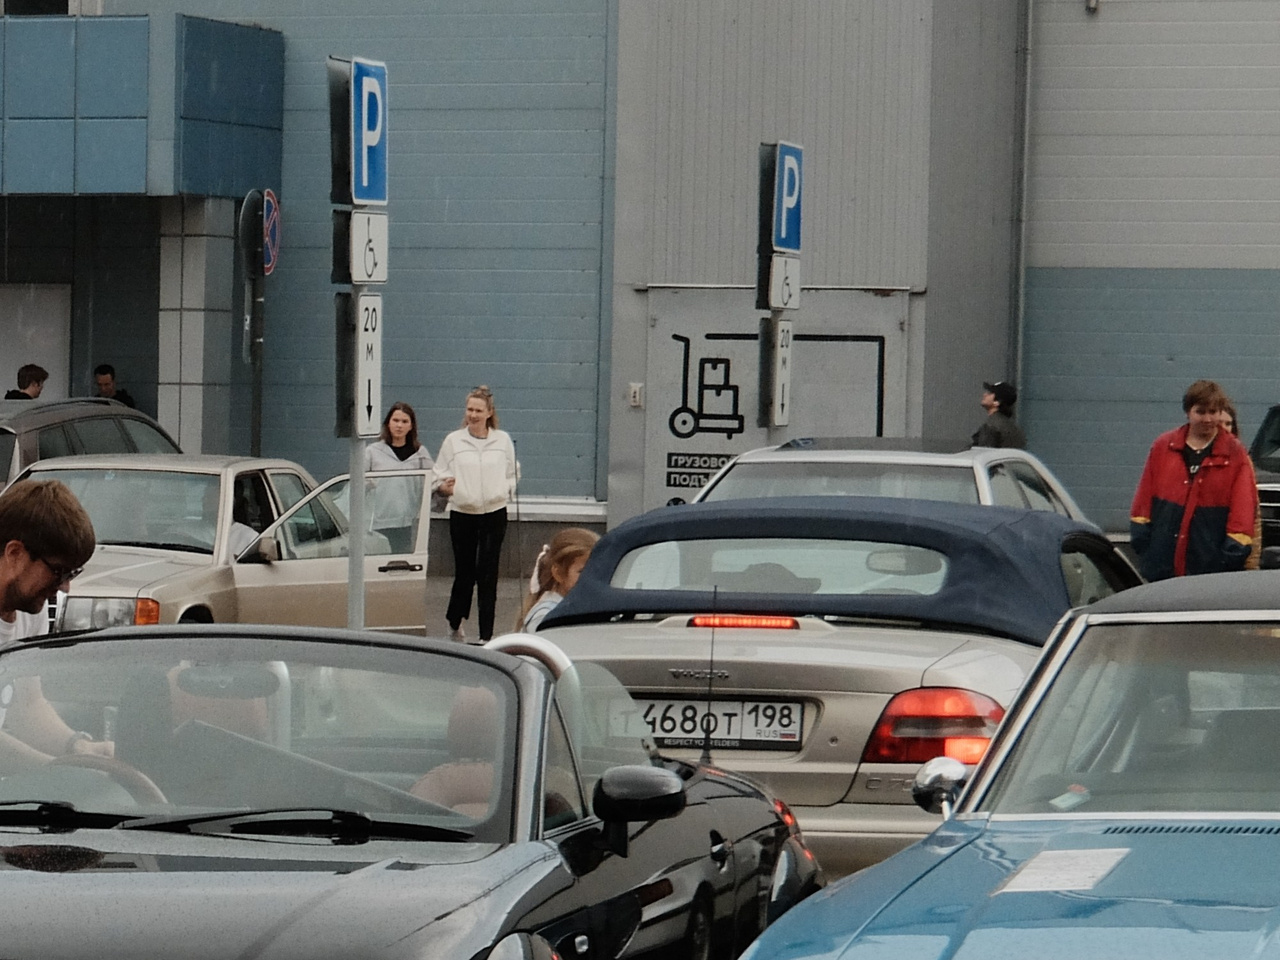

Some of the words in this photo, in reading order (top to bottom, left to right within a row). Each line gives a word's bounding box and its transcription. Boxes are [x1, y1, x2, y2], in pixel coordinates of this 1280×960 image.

[361, 76, 383, 187] P
[781, 155, 800, 239] P
[363, 306, 378, 333] 20
[780, 328, 790, 349] 20
[671, 455, 733, 468] ГРУЗОВО
[747, 703, 793, 729] 198
[756, 729, 779, 739] RUS
